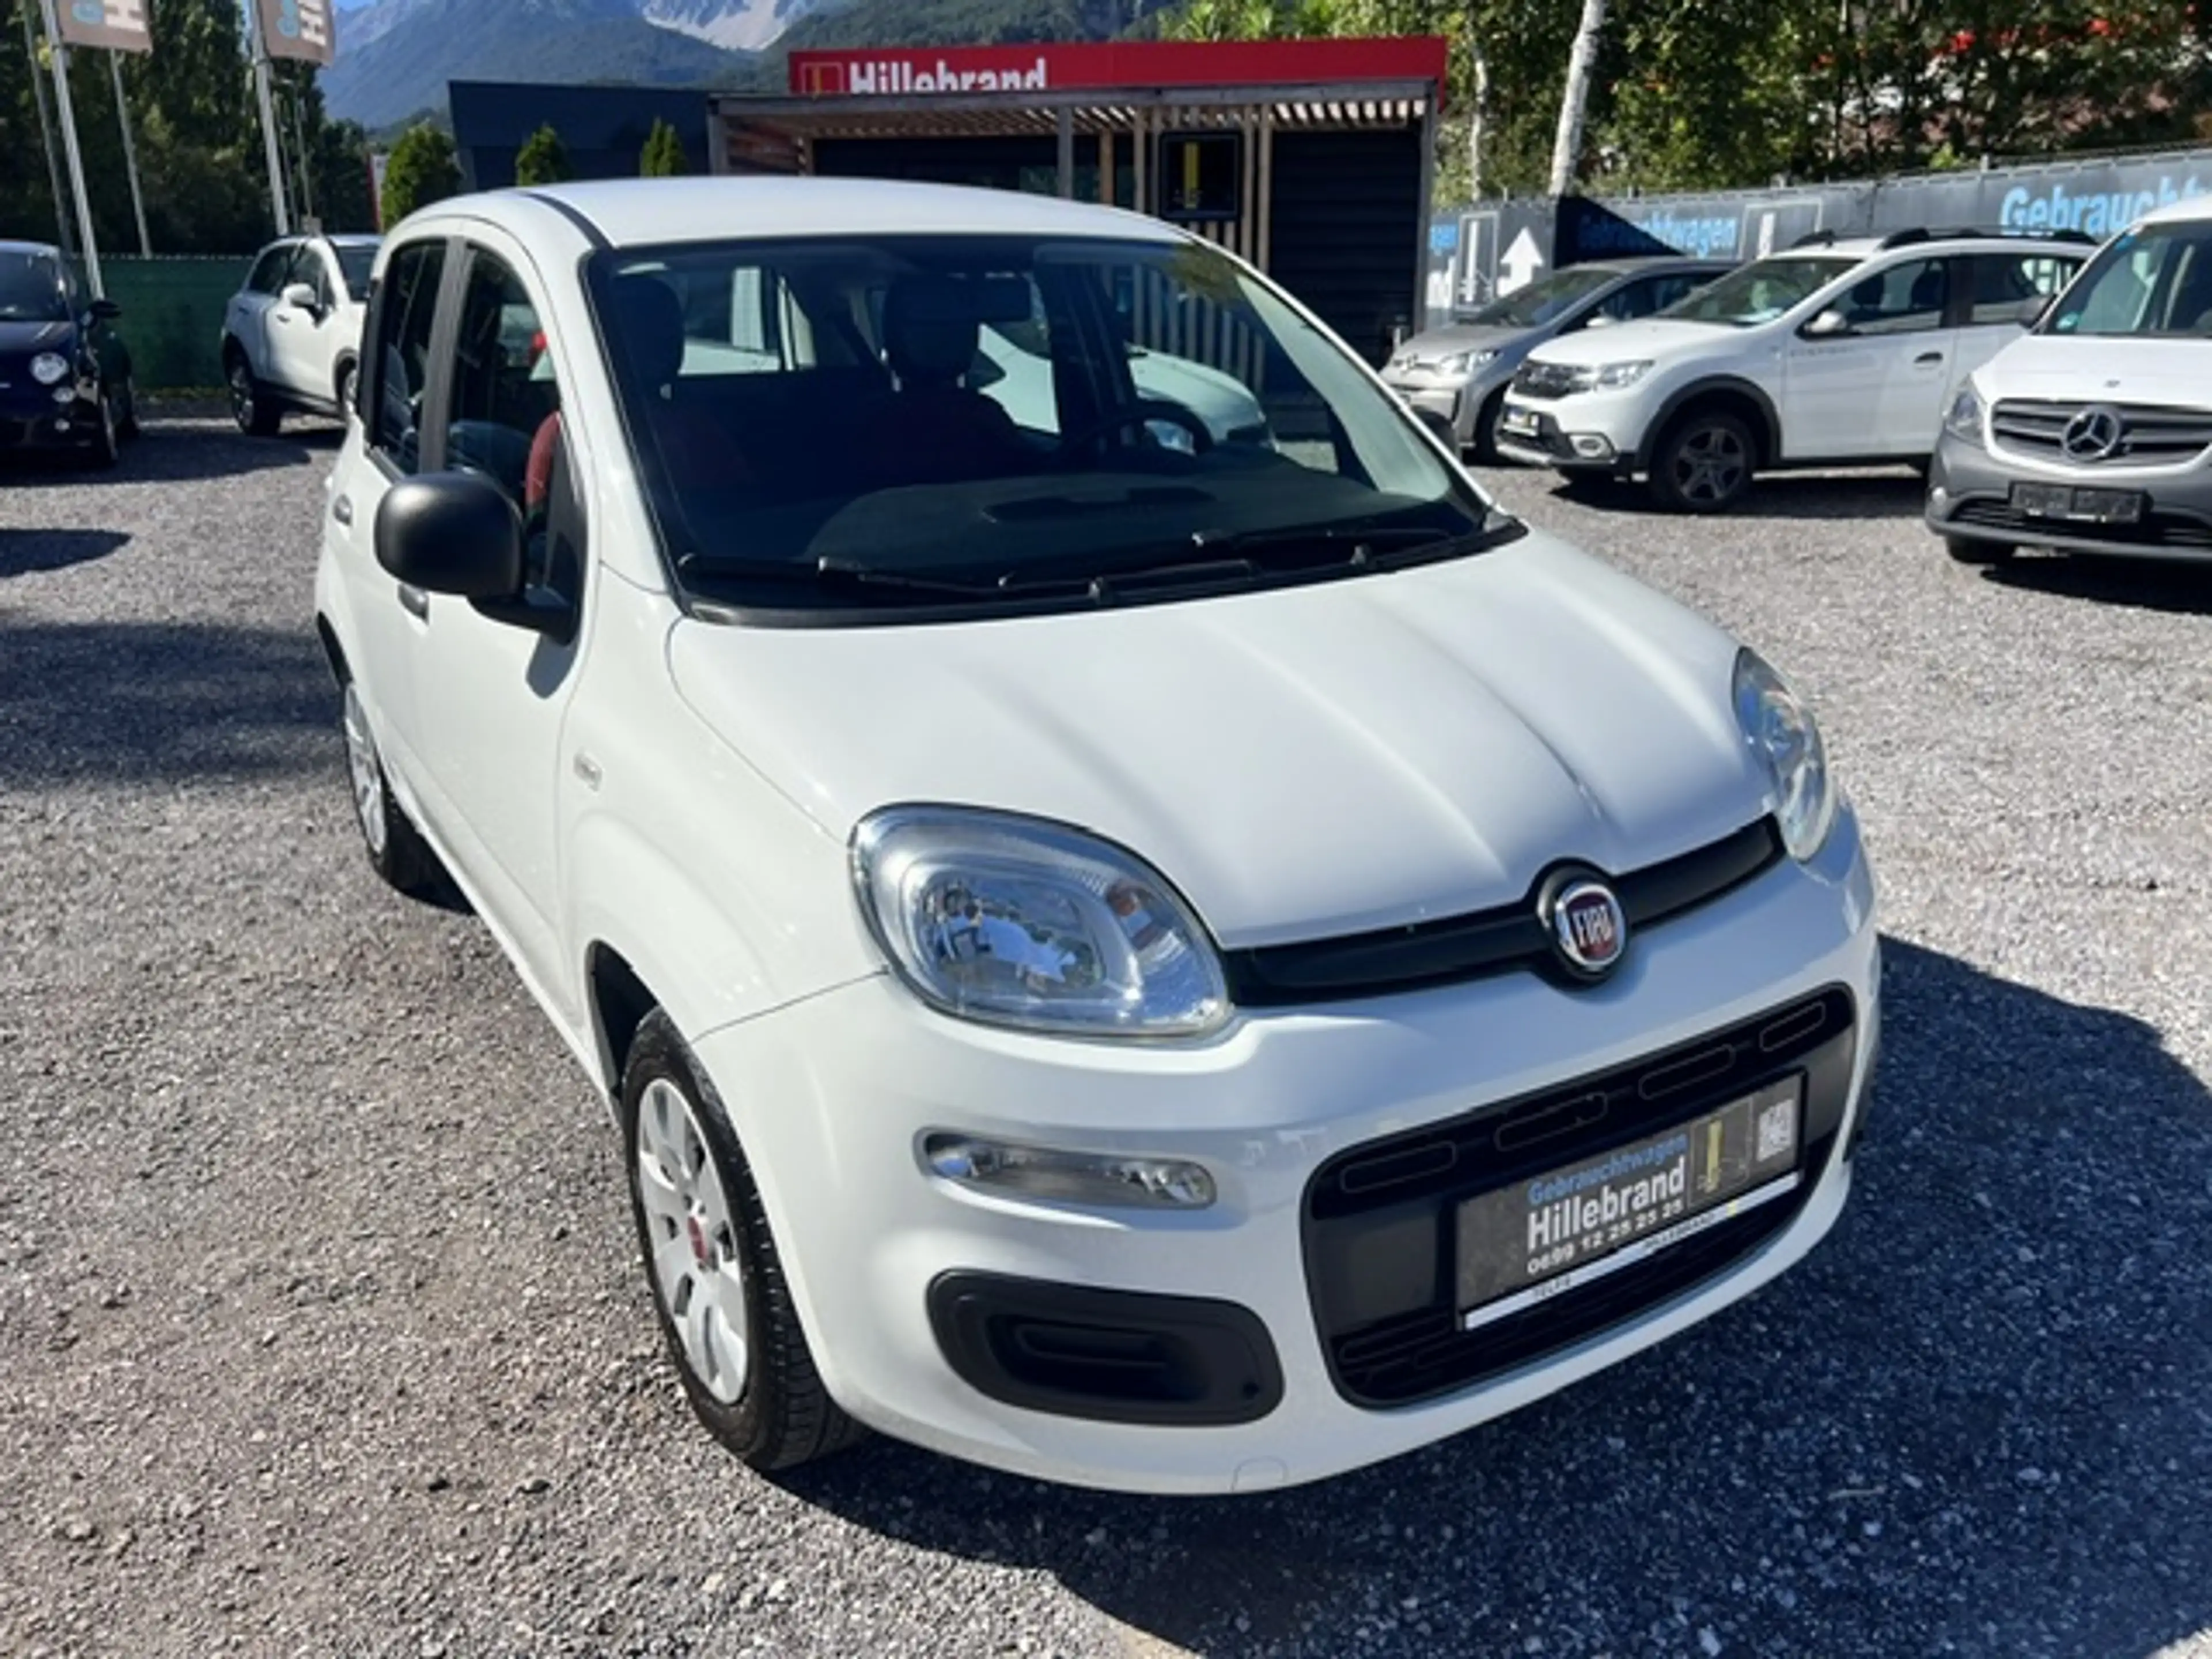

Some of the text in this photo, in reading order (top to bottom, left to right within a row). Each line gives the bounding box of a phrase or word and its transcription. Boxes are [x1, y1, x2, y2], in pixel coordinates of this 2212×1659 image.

[849, 56, 1047, 94] Hillebrand
[1571, 902, 1612, 948] FIAT
[1528, 1132, 1687, 1206] Gebrauchtwagen
[1527, 1154, 1685, 1256] Hillebrand
